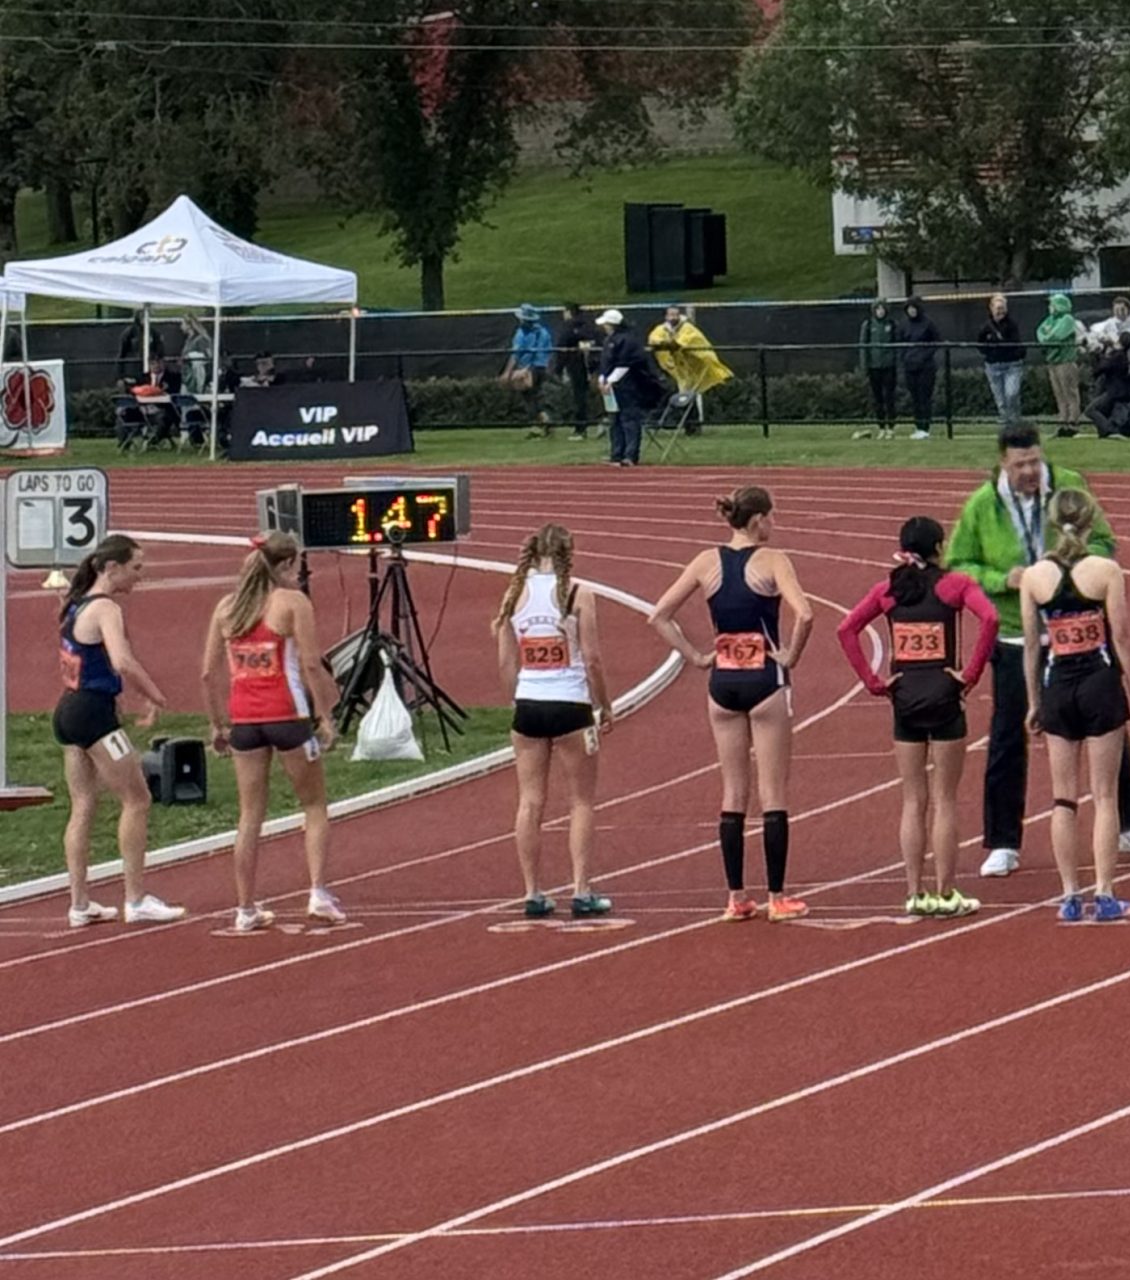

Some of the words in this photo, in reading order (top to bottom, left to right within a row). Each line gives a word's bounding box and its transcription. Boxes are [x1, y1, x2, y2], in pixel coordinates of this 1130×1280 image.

[299, 406, 338, 423] VIP
[251, 430, 336, 447] Accueil
[341, 425, 379, 443] VIP
[18, 474, 49, 492] LAPS
[54, 474, 72, 492] TO
[77, 474, 95, 492] GO
[63, 497, 95, 548] 3
[898, 633, 939, 651] 733
[1055, 623, 1100, 645] 638
[525, 645, 564, 664] 829
[723, 642, 758, 661] 167
[109, 734, 125, 755] 1
